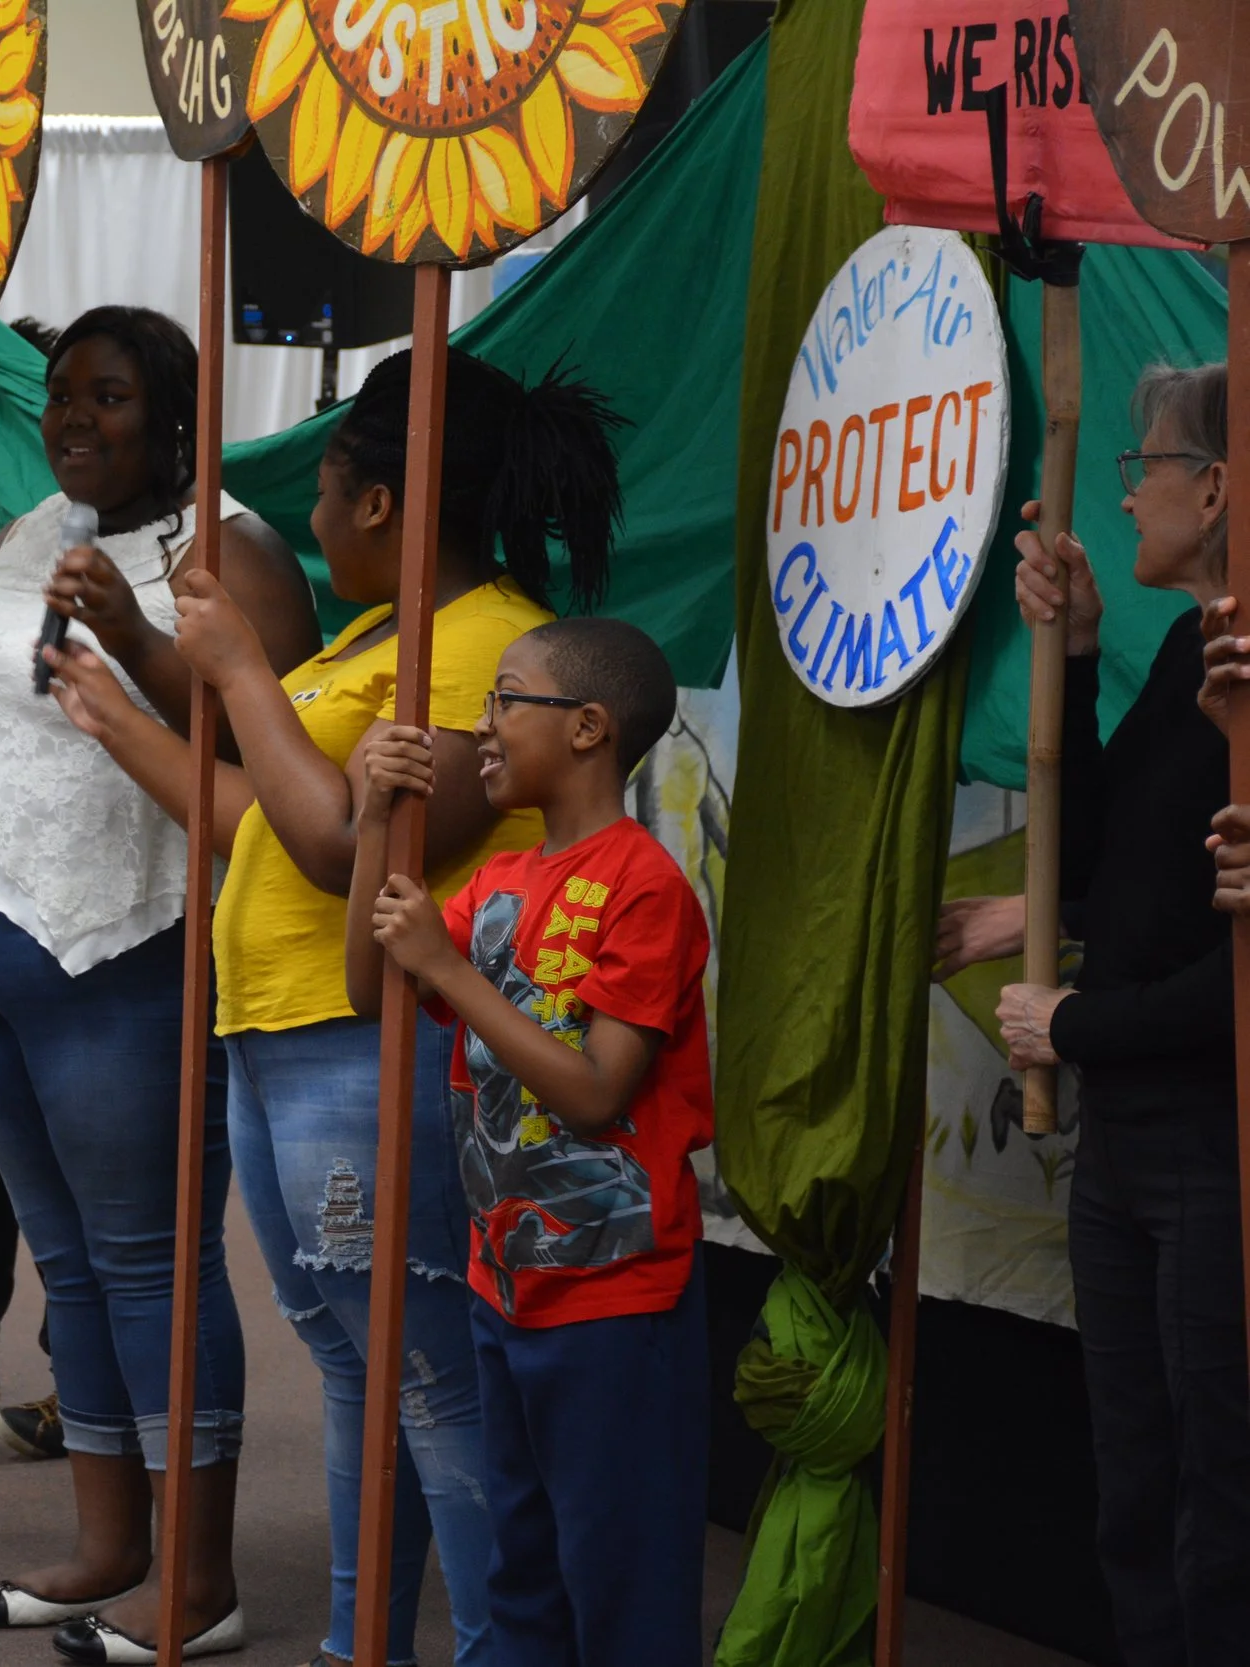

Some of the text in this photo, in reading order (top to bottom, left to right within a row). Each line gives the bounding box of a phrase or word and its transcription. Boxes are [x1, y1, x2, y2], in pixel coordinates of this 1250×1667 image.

[333, 0, 537, 106] USTIC
[924, 14, 1091, 116] WE RIS
[773, 381, 992, 533] PROTECT
[773, 516, 970, 693] CLIMATE
[519, 875, 591, 1150] PANTR
